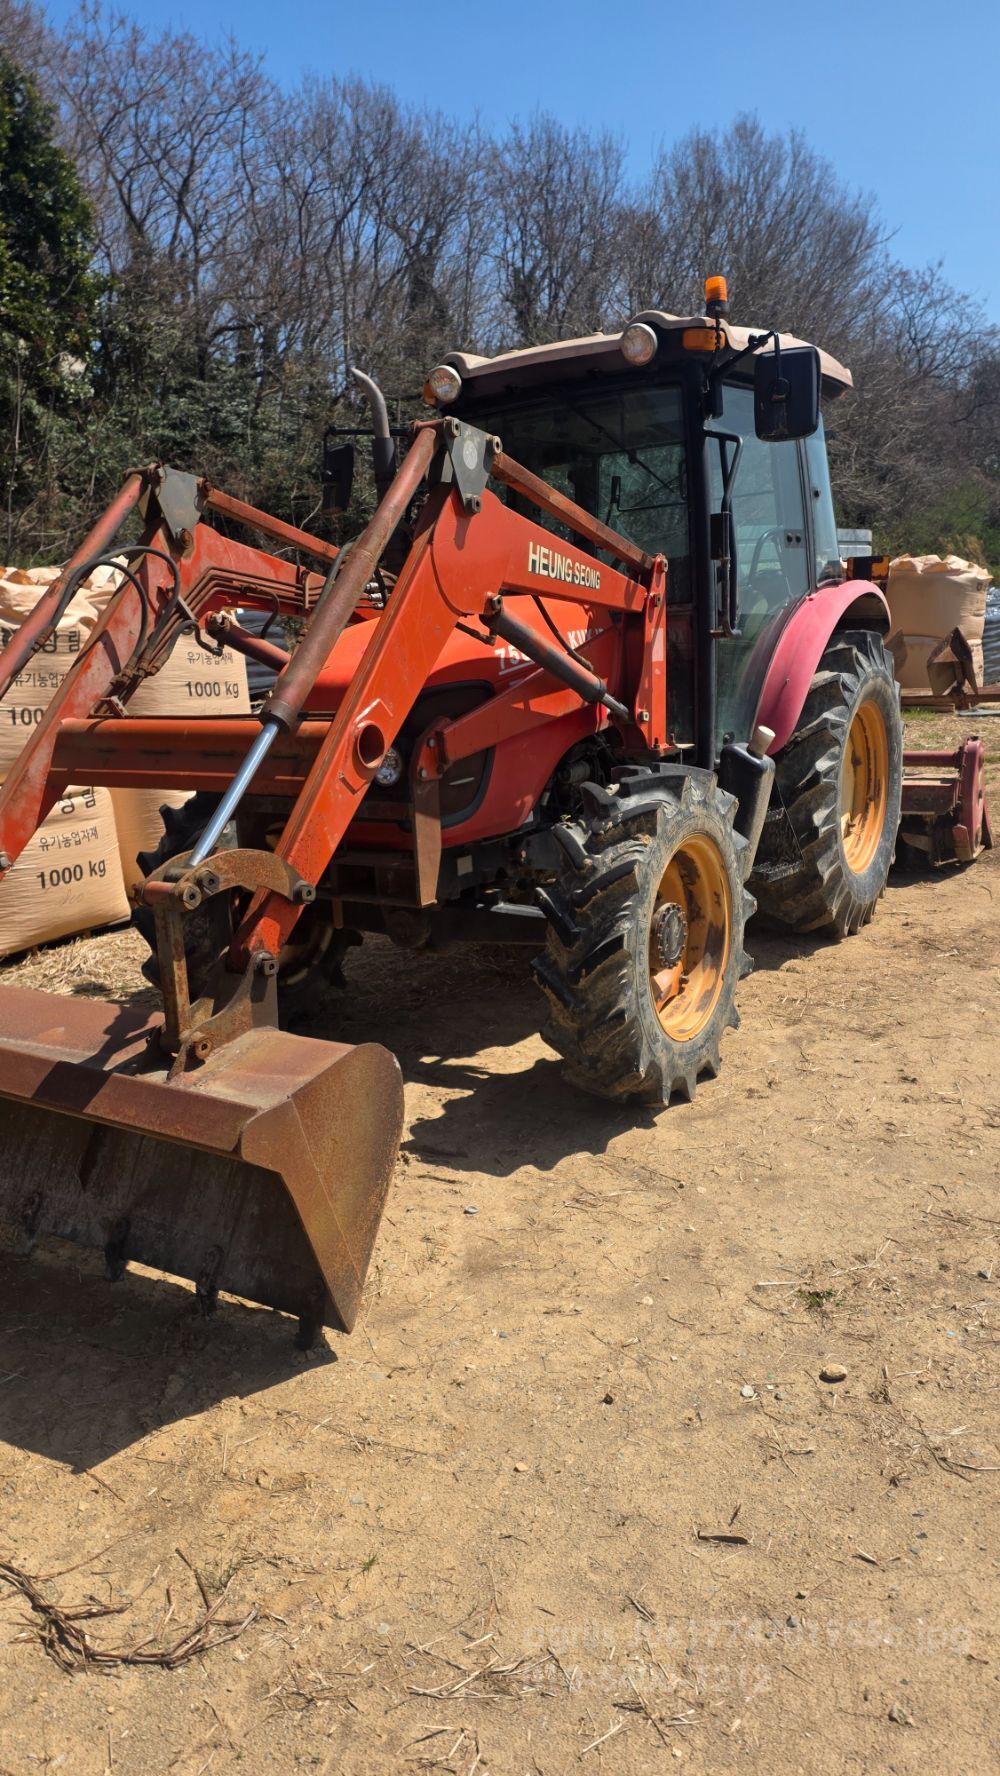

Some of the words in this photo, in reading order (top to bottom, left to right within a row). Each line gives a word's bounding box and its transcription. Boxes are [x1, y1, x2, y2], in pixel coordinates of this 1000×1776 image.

[528, 541, 573, 583] HEUNG
[574, 562, 601, 590] SEONG
[187, 651, 234, 666] 유기농업자재
[186, 681, 221, 697] 1000
[225, 681, 239, 699] kg
[39, 826, 98, 851] 유기농업자재
[37, 864, 83, 889] 1000
[88, 859, 106, 877] kg
